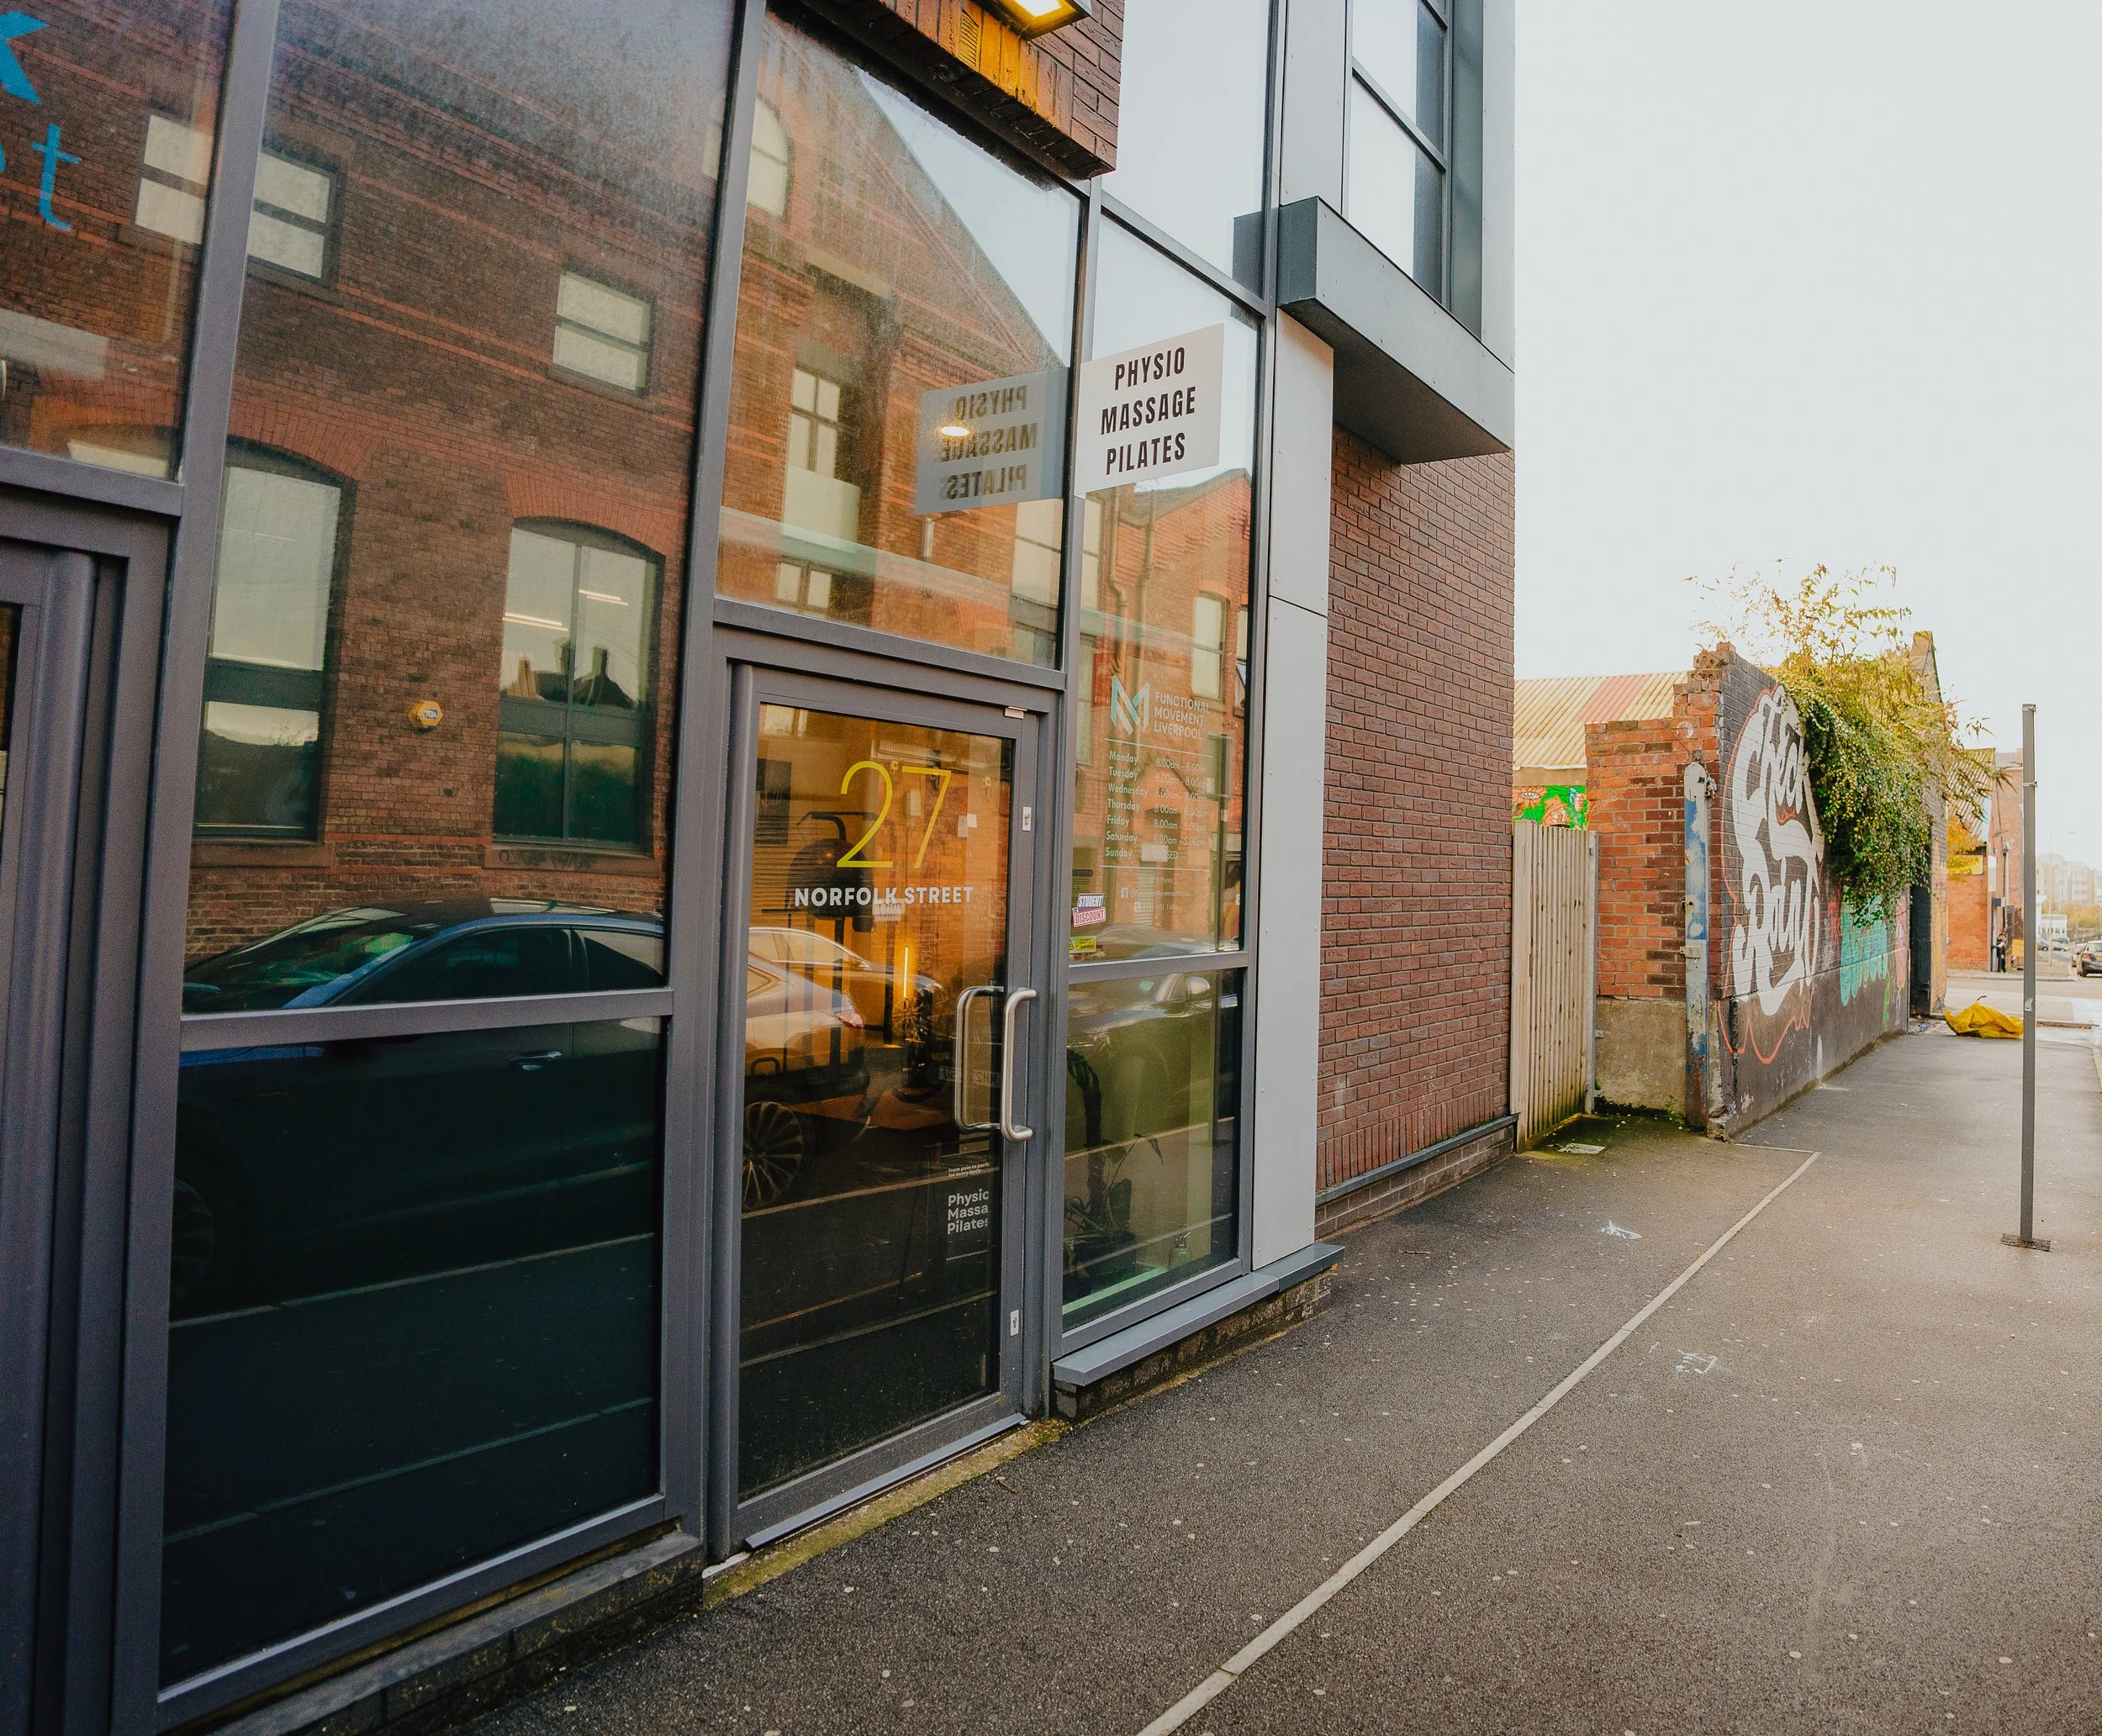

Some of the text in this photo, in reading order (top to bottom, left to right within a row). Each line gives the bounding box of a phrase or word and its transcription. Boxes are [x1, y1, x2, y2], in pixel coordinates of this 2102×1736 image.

[1114, 346, 1186, 391] PHYSIO
[1101, 386, 1196, 435] MASSAGE
[1106, 432, 1186, 475] PILATES
[1155, 691, 1211, 714] FUNCTIONAL
[1154, 706, 1205, 726] MOVEMENT
[1154, 720, 1202, 740] LIVERPOOL
[1109, 751, 1138, 765] Monday
[1156, 757, 1180, 769] 8.00am
[1108, 767, 1138, 781] Tuesday
[1155, 773, 1180, 784] 8.00am
[1107, 783, 1149, 797] Wednesday
[1155, 789, 1179, 799] 8.00am
[1185, 792, 1208, 803] 8.00pm
[837, 761, 952, 868] 27
[1107, 799, 1140, 813] Thursday
[1154, 804, 1179, 815] 8.00am
[1106, 815, 1130, 828] Friday
[1154, 819, 1178, 830] 8.00am
[1106, 831, 1138, 844] Saturday
[1153, 835, 1178, 845] 8.00am
[1106, 847, 1178, 860] Sunday CLOSED
[795, 886, 974, 907] NORFOLK STREET
[1078, 895, 1103, 908] STUDENT
[1075, 910, 1104, 924] DISCOUNT
[948, 1205, 989, 1221] Massa
